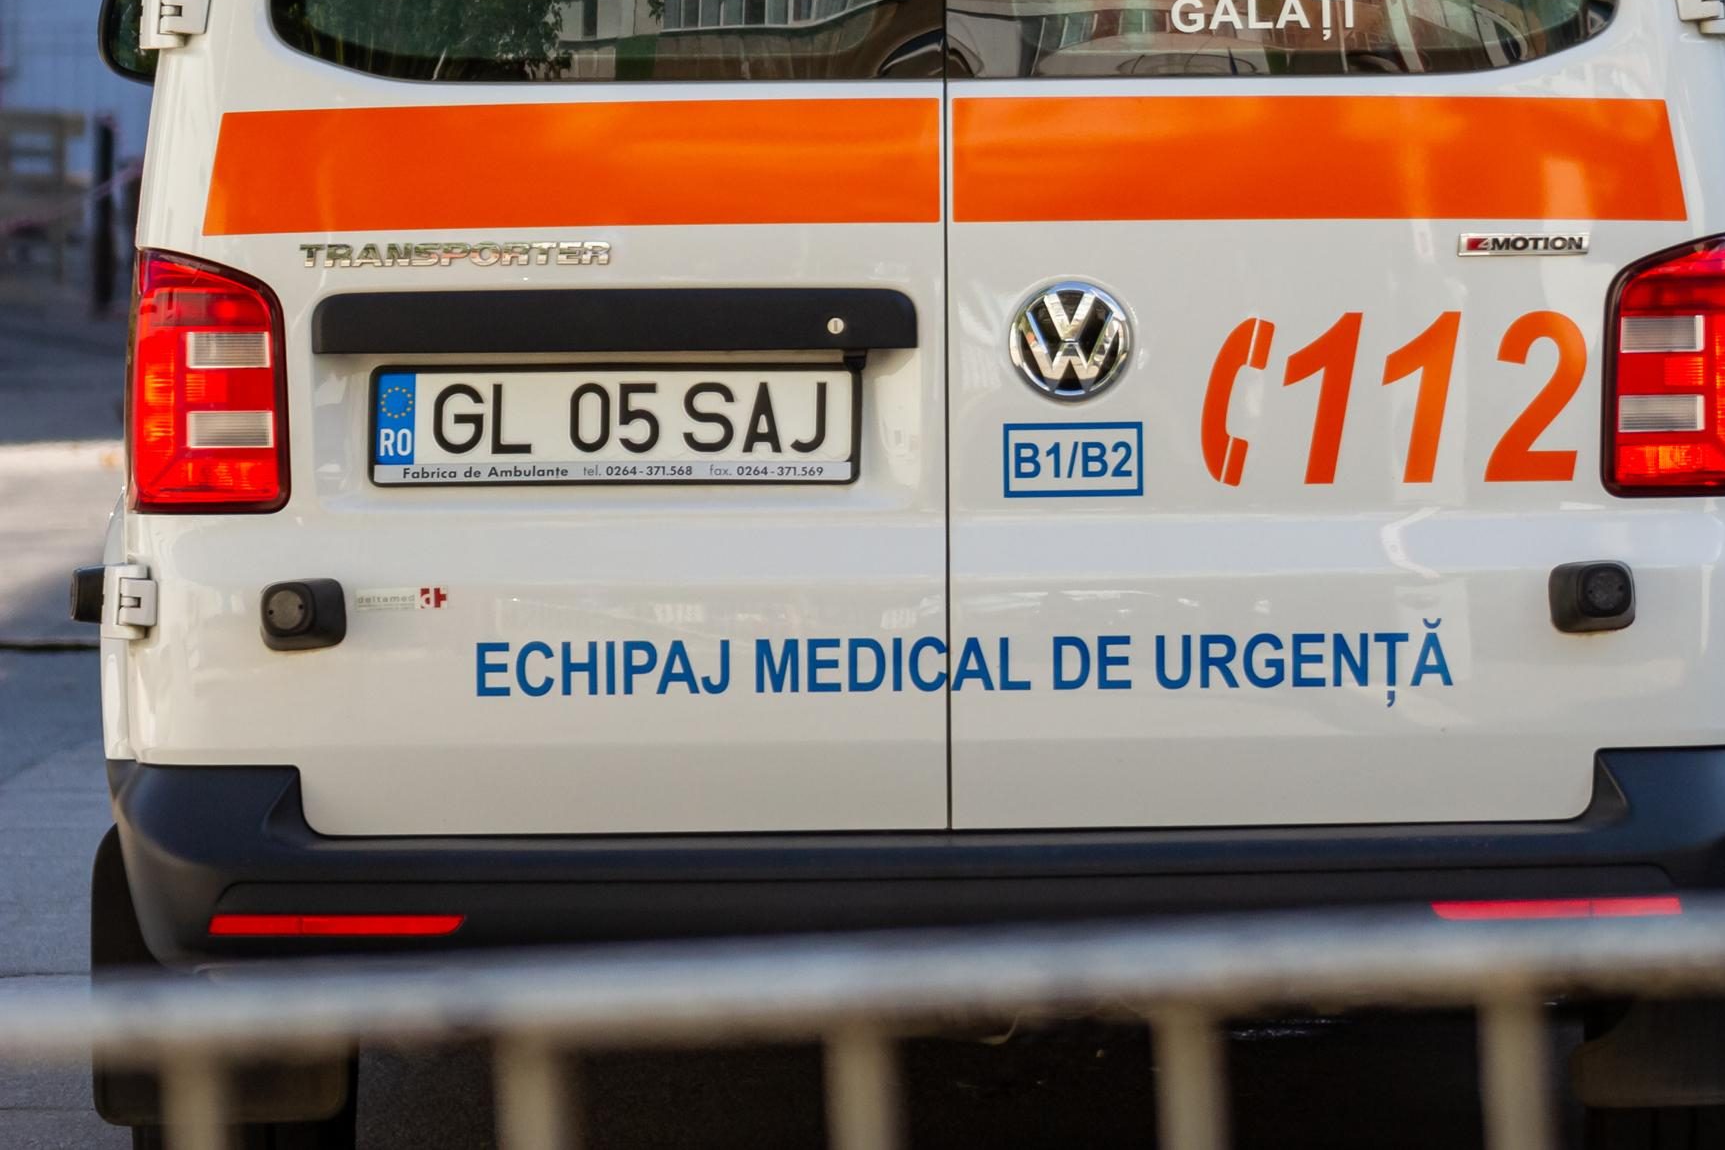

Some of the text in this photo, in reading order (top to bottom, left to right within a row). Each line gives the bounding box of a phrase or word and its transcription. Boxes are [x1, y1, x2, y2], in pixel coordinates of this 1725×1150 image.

[300, 241, 611, 268] TRANSPORTER
[1282, 311, 1587, 485] 112
[432, 382, 828, 456] GL 05 SAJ
[379, 428, 413, 456] RO
[402, 467, 457, 479] Fabrica
[464, 466, 481, 478] de
[583, 465, 601, 476] tel.
[709, 464, 732, 476] fax.
[1014, 441, 1133, 479] B1/B2
[357, 594, 416, 603] deltamed
[476, 617, 1454, 707] ECHIPAJ MEDICAL DE URGENȚĂ
